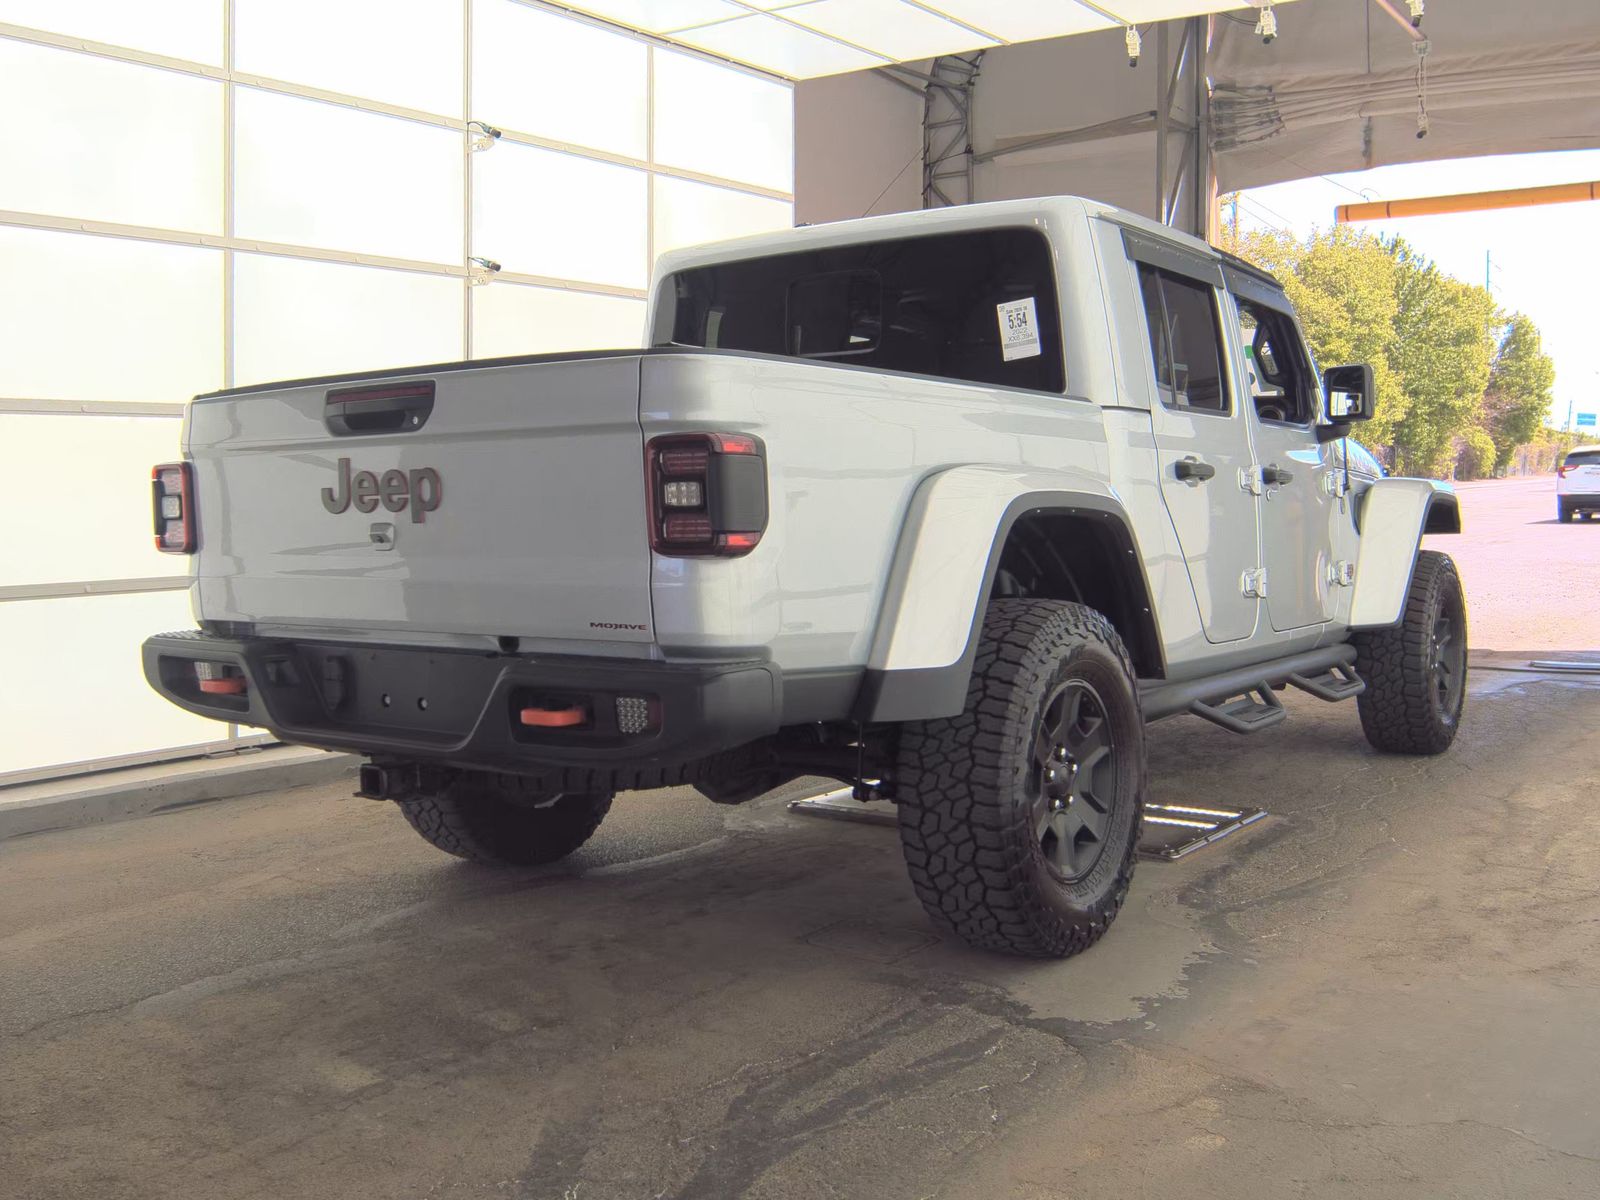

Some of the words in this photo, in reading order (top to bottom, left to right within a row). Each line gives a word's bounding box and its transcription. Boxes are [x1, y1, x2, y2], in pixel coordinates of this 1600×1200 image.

[1008, 312, 1028, 329] 5:54
[321, 457, 442, 524] Jeep
[589, 622, 647, 631] MOJAVE
